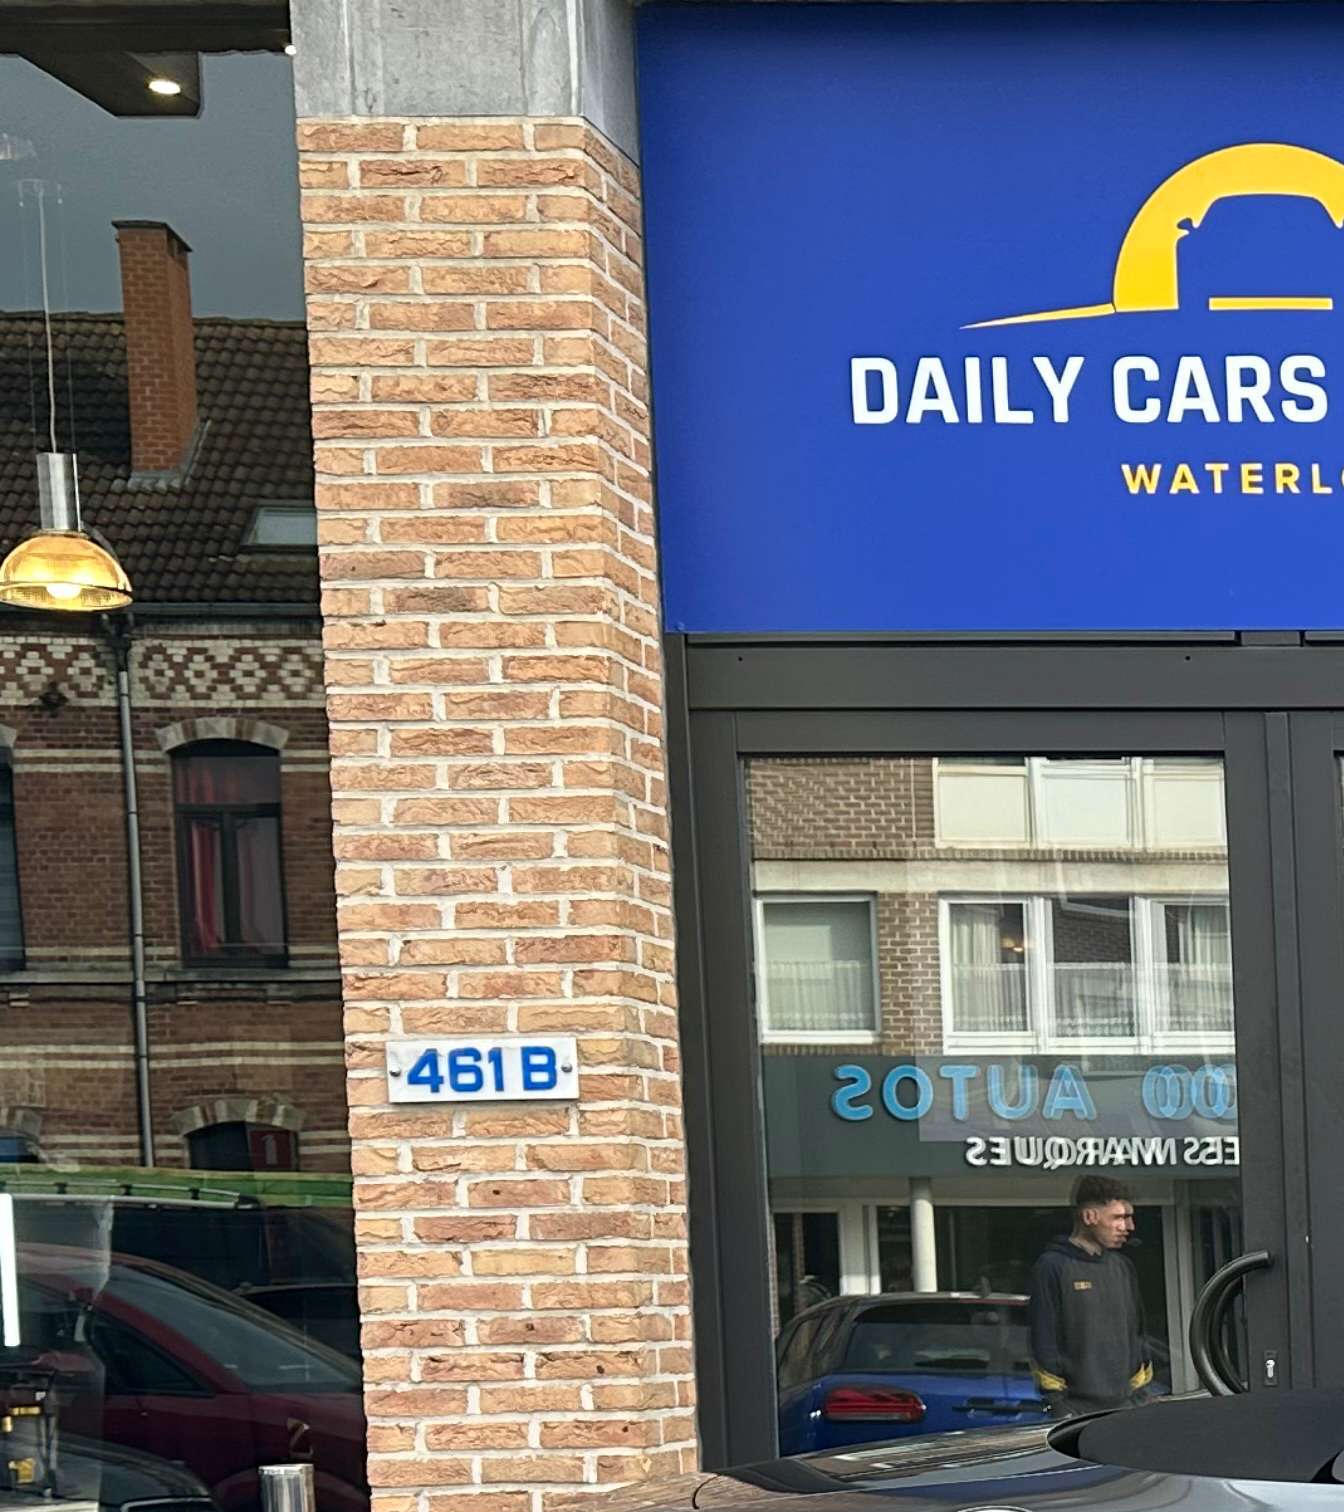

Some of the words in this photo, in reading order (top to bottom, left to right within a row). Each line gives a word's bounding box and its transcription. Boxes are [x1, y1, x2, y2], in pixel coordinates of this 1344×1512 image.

[852, 357, 1084, 424] DAILY
[1114, 356, 1327, 423] CARS
[408, 1048, 504, 1092] 461
[521, 1047, 557, 1090] B
